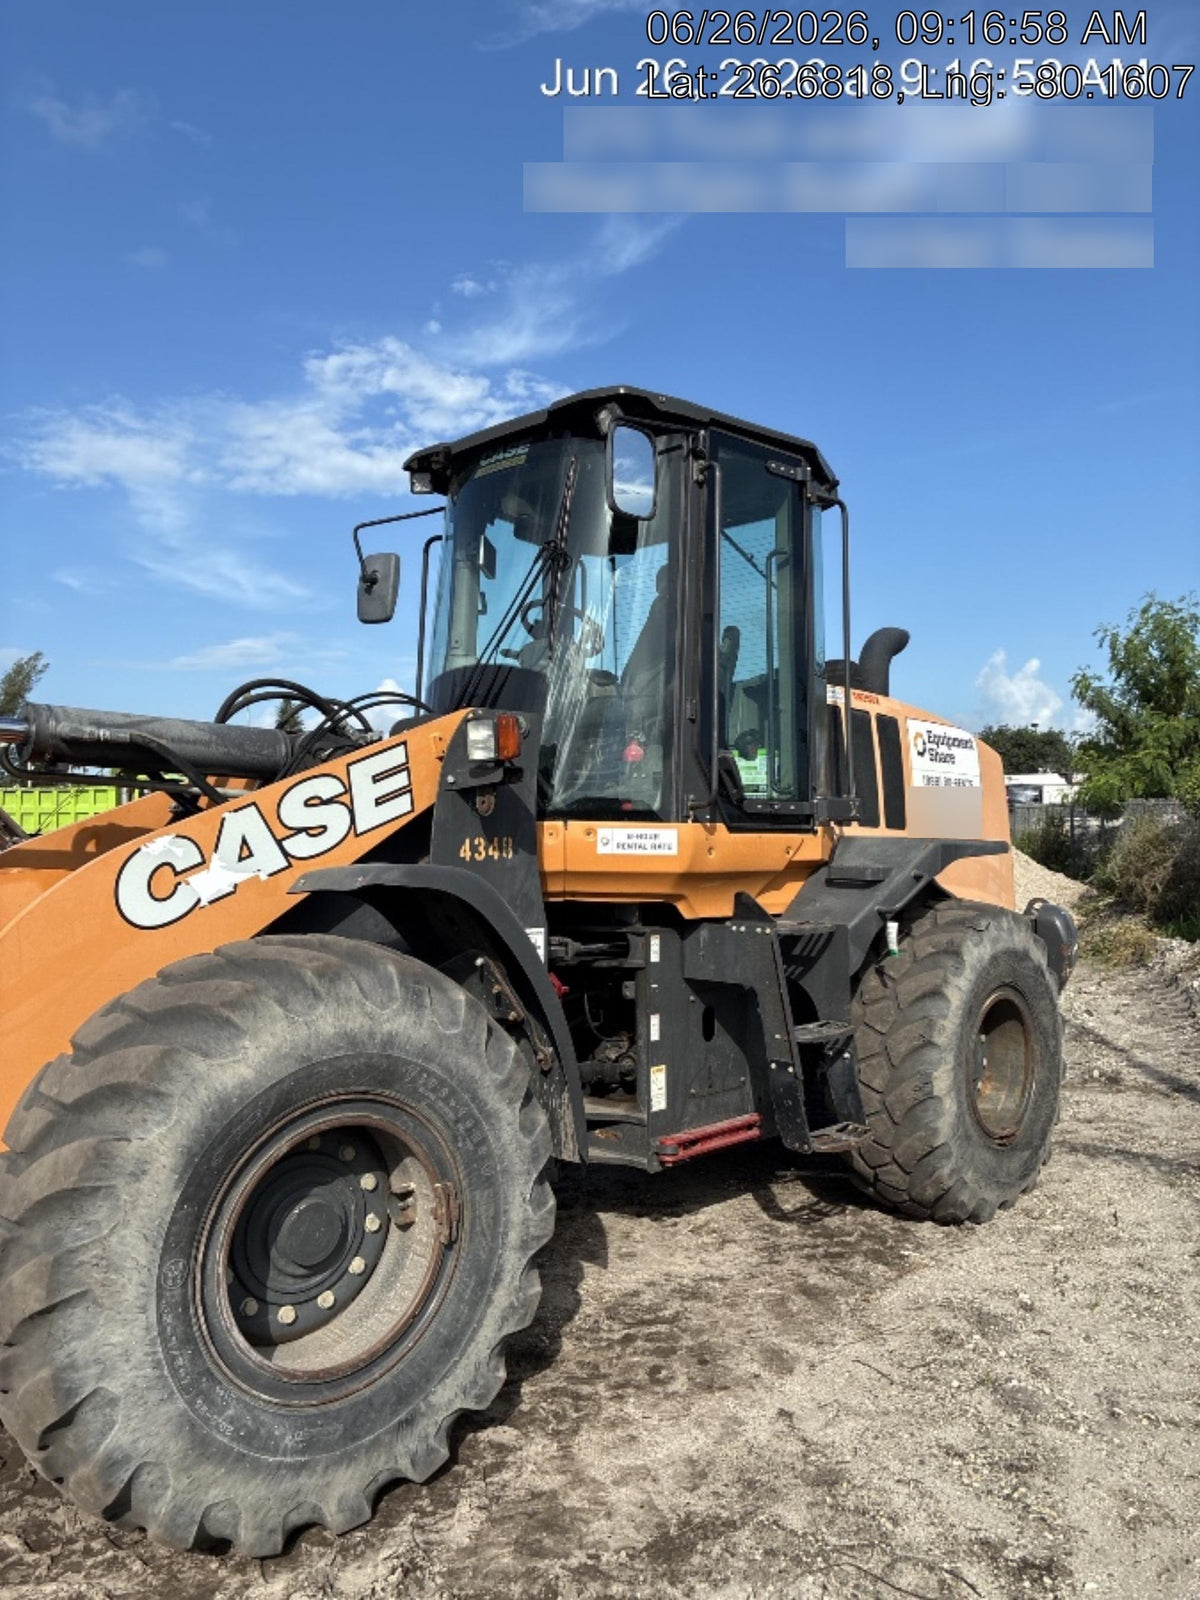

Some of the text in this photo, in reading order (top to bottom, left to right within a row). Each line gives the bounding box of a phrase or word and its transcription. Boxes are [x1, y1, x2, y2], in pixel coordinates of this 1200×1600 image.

[925, 730, 975, 751] Equipment
[927, 747, 956, 765] Share
[114, 740, 415, 931] CASE
[459, 836, 513, 862] 4348
